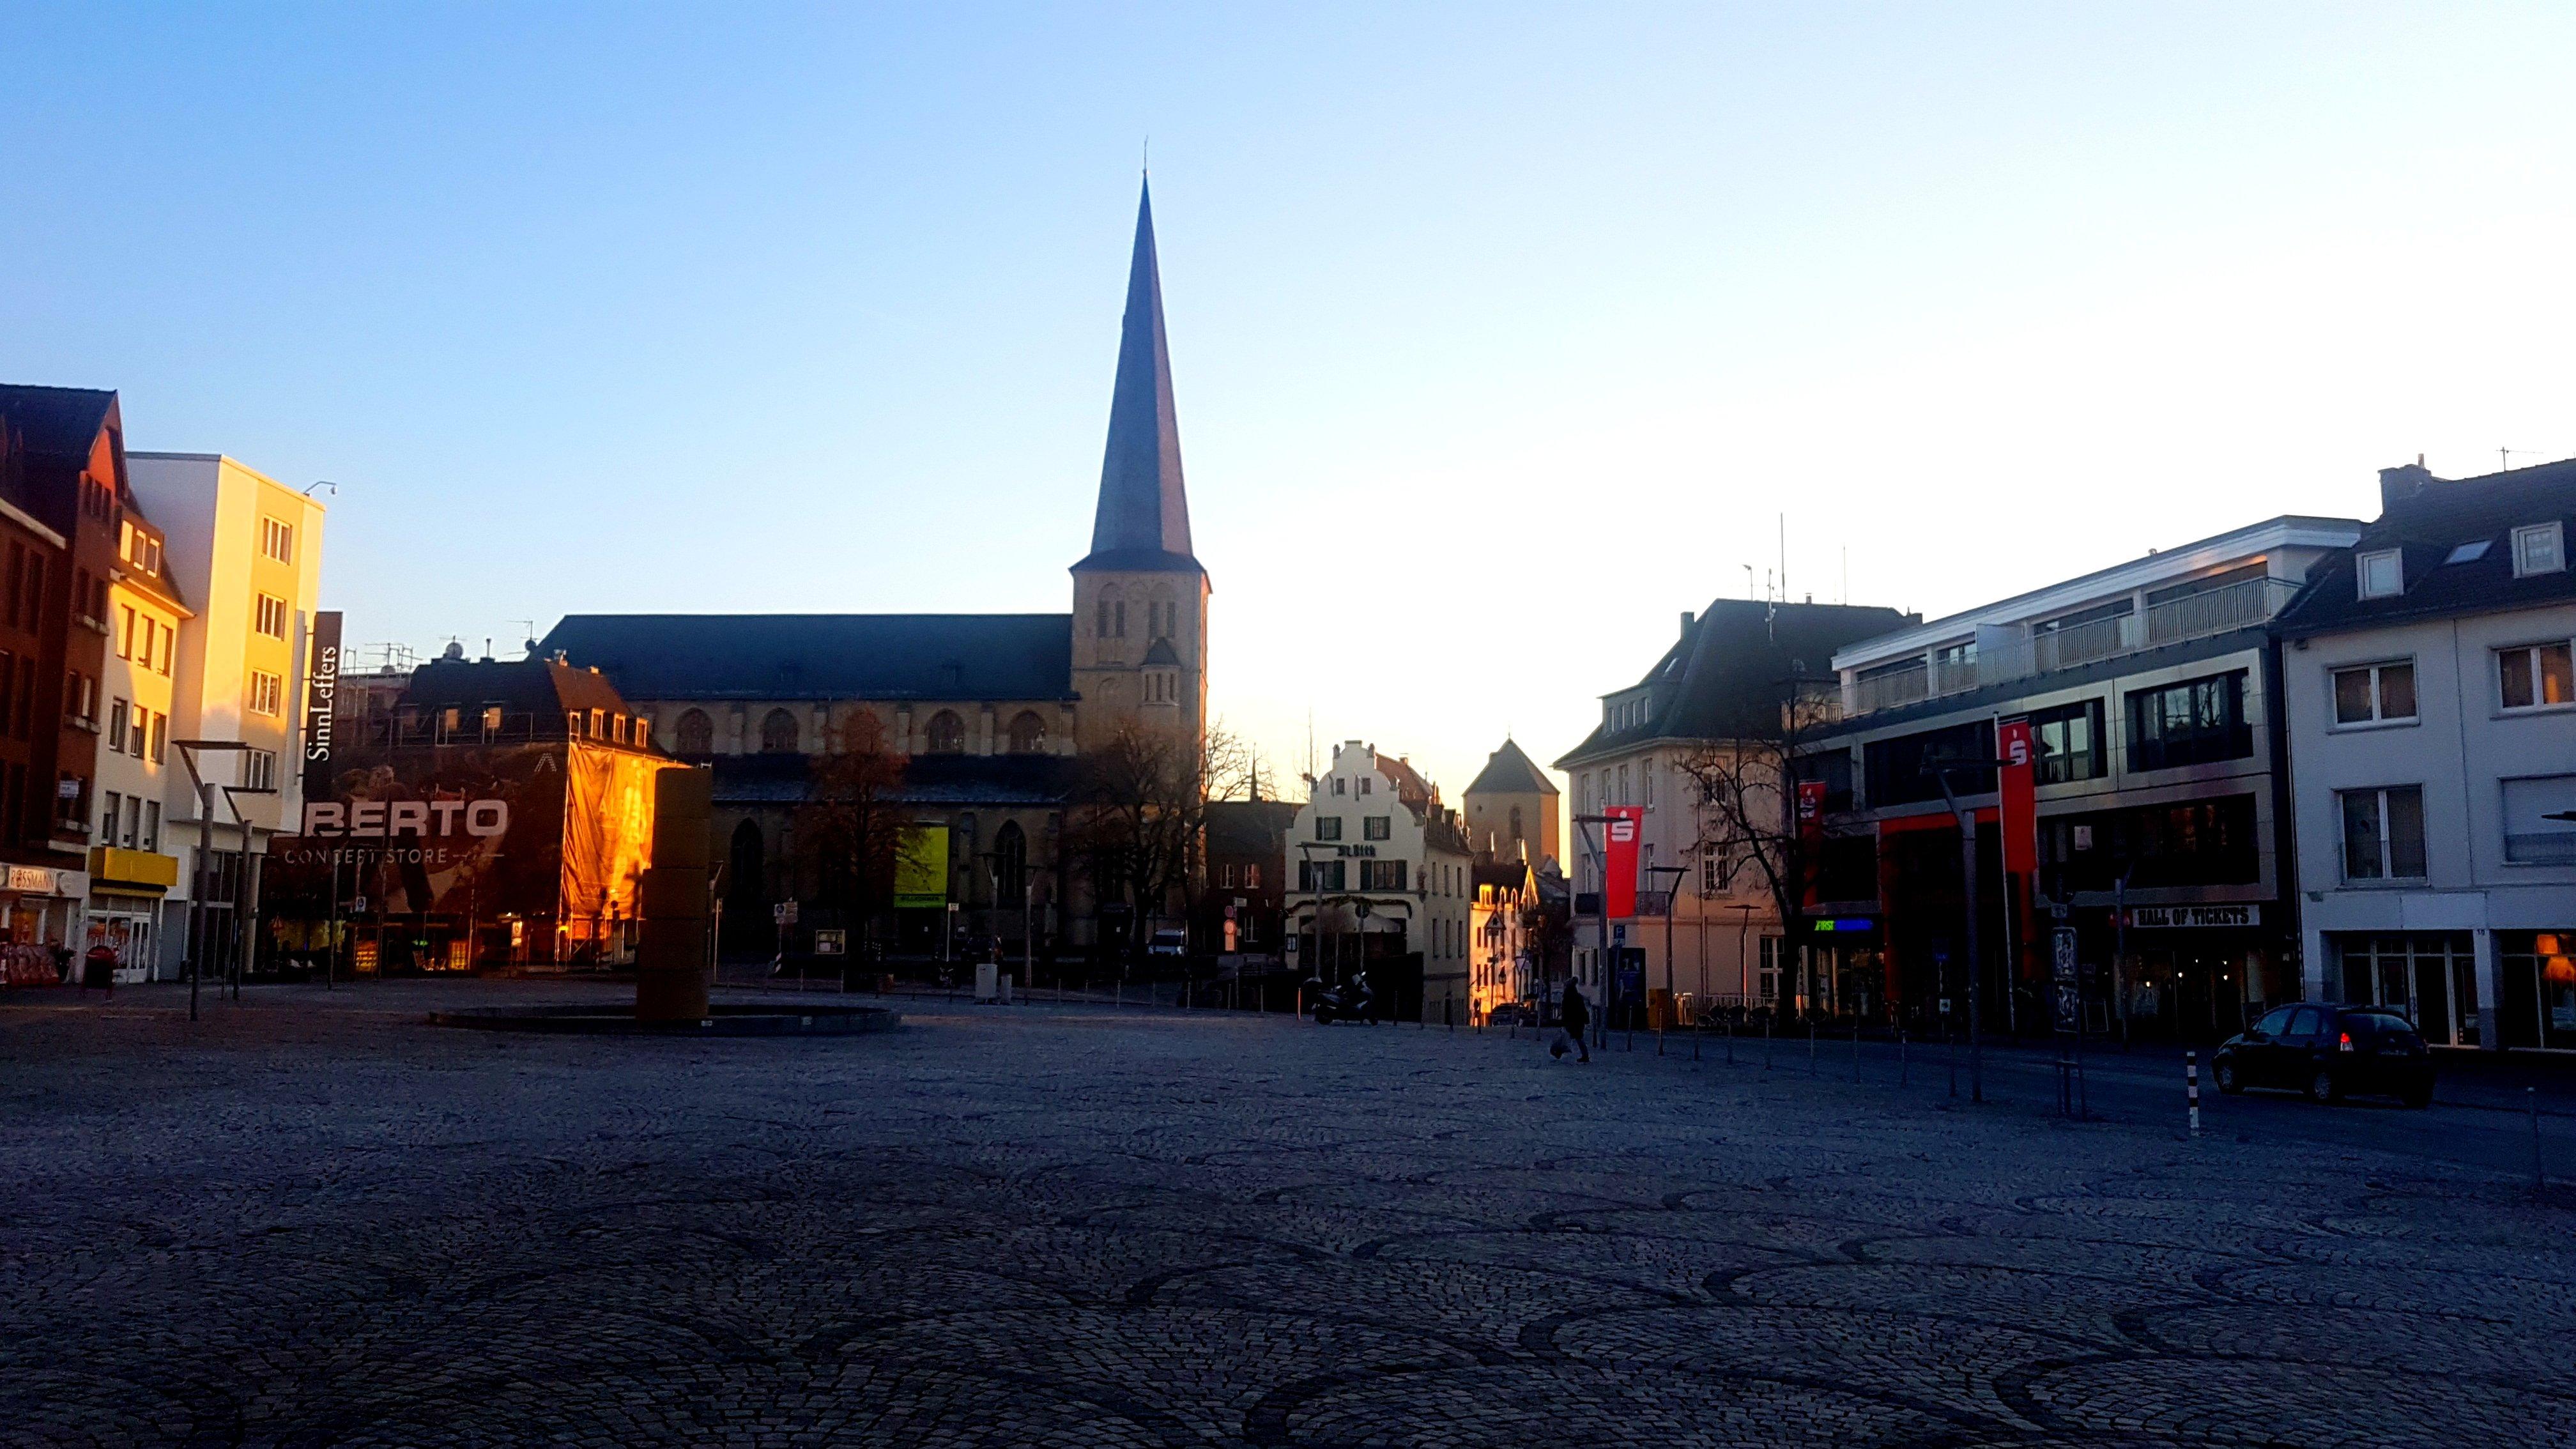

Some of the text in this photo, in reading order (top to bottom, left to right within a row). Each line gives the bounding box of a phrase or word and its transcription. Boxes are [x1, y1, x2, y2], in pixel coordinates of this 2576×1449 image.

[306, 646, 337, 762] SinnLeffers
[272, 800, 509, 838] BERTO
[386, 847, 448, 864] STORE
[10, 870, 56, 890] ROSSMANN
[2138, 906, 2250, 926] HALL OF TICKETS
